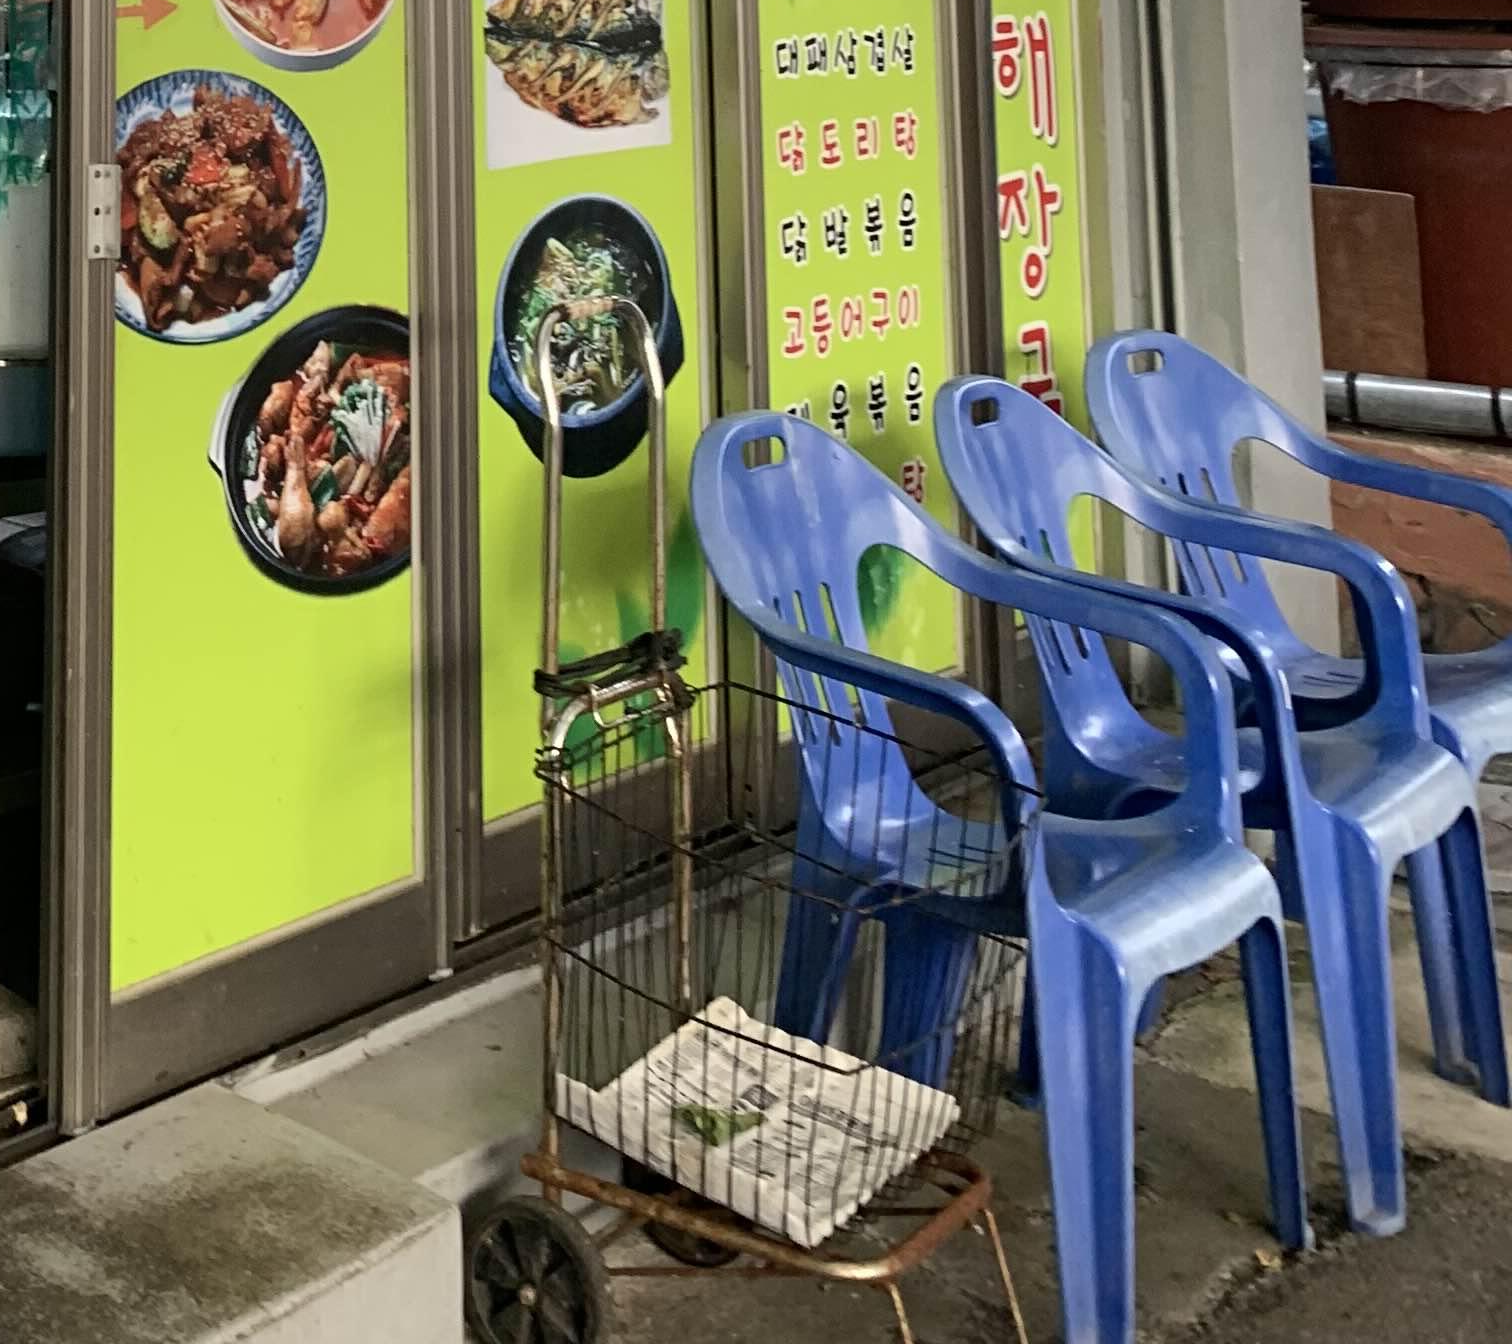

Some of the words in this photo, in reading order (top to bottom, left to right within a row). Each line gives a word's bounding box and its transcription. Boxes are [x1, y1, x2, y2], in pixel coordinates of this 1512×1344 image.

[774, 23, 915, 79] 대패삼겹살
[777, 108, 917, 176] 닭도리탕
[782, 283, 919, 357] 고등어구이
[786, 362, 924, 441] 육볶음
